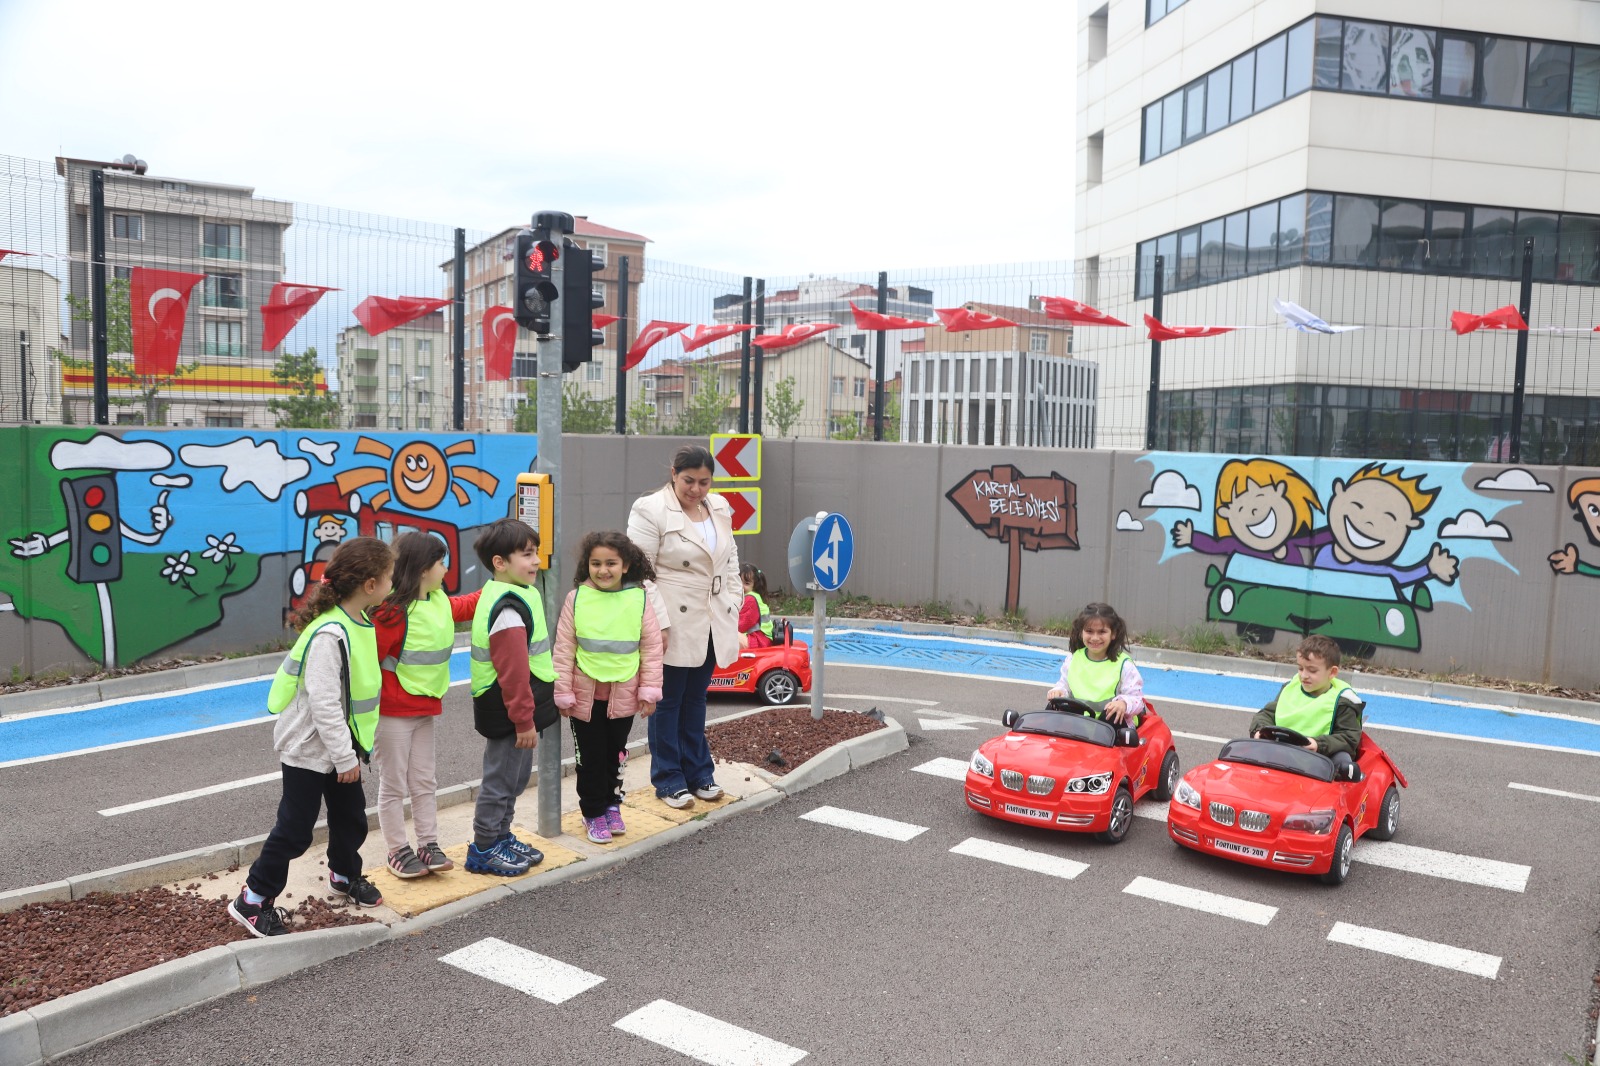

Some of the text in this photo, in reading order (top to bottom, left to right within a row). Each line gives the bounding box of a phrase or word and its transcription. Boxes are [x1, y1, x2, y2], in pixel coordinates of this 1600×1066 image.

[973, 480, 1026, 500] KARTAL
[1006, 804, 1029, 815] FORTUNE
[1215, 839, 1241, 852] FORTUNE
